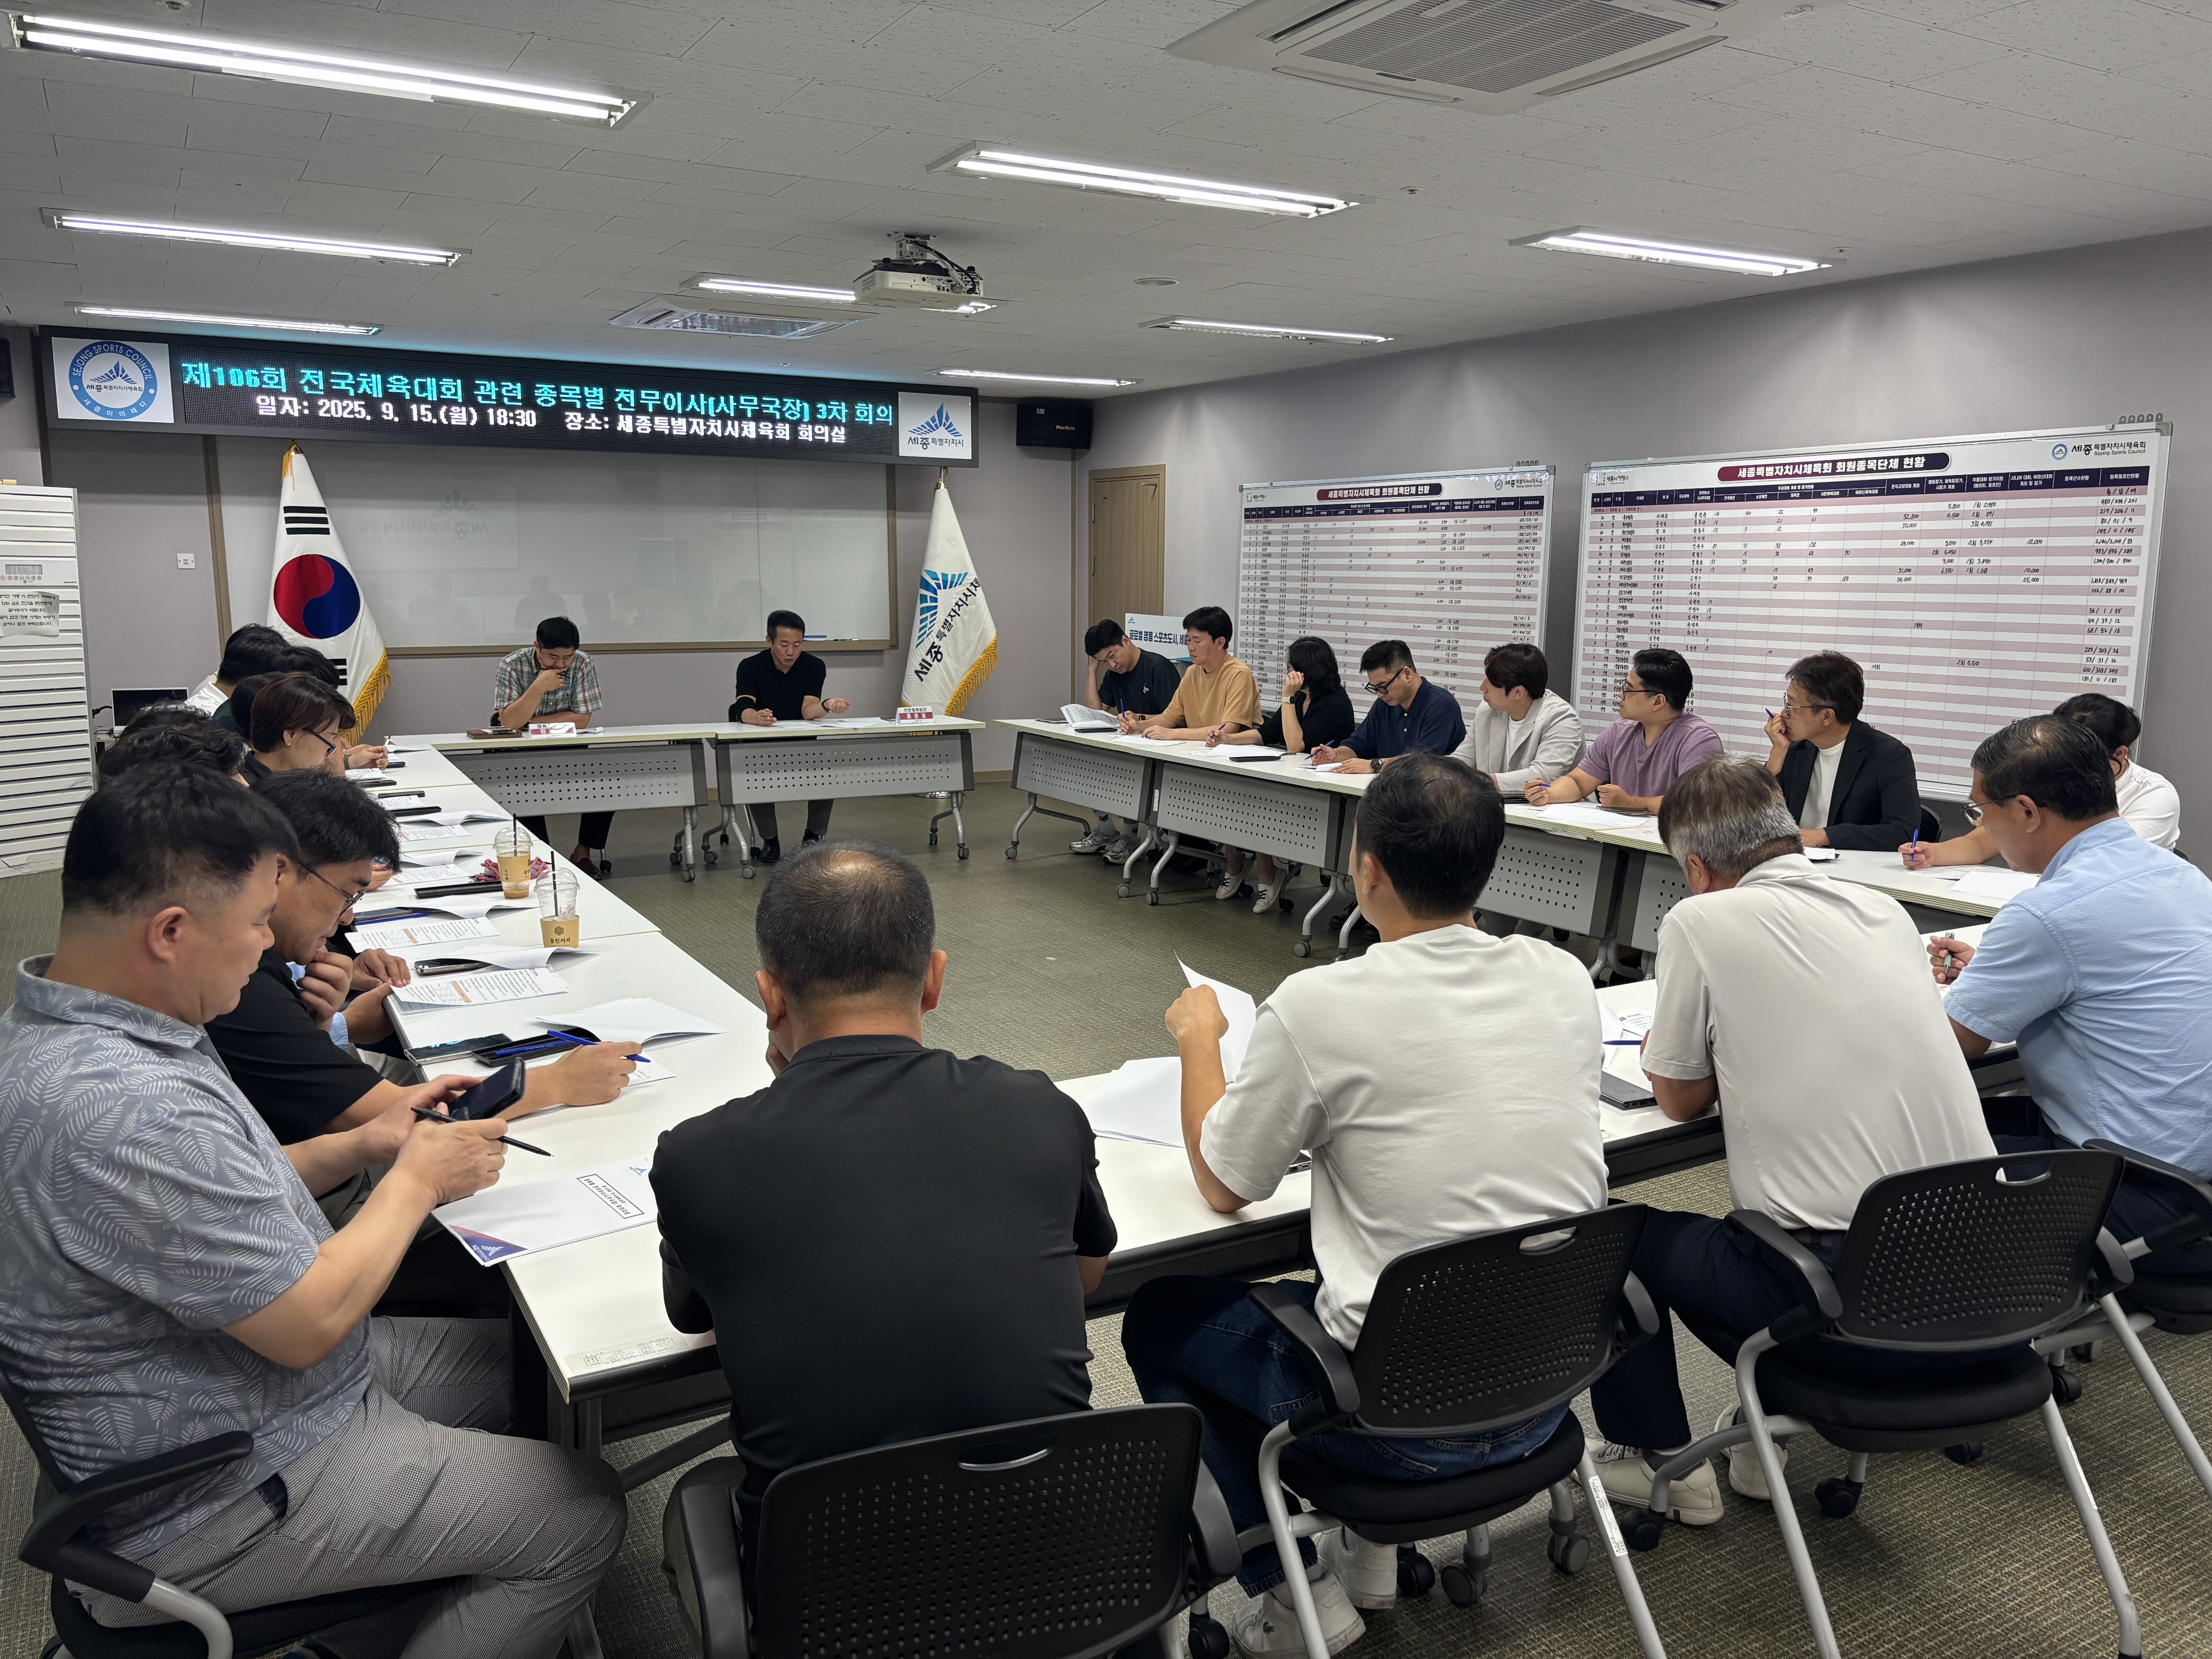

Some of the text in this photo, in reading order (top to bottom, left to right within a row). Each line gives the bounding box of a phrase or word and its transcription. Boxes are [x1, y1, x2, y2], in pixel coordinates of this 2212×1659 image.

[72, 343, 153, 380] SEJONG SPORTS COUNCIL
[181, 362, 286, 392] 제106회
[300, 369, 462, 402] 전국체육대회
[474, 380, 522, 405] 관련
[534, 384, 604, 409] 종목별
[817, 402, 848, 422] 3차
[855, 403, 892, 425] 회의
[256, 395, 309, 416] 일자:
[318, 399, 371, 420] 2025.
[381, 402, 399, 422] 9.
[487, 408, 536, 427] 18:30
[564, 412, 609, 430] 장소:
[617, 415, 789, 440] 세종특별자치시체육회
[798, 424, 845, 443] 회의실
[908, 436, 963, 450] 세종 특별자치시
[2071, 441, 2146, 455] 세종 특별자치시체육회
[1738, 456, 1925, 478] 세종특별자치시체육회 회원종목단체 현황
[1328, 485, 1430, 498] 세종특별자치시체육회 회원종목단체 현황
[1129, 630, 1143, 641] 글로벌
[1144, 631, 1153, 642] 명품
[1154, 632, 1178, 645] 스포츠도시,
[914, 641, 943, 682] 세종
